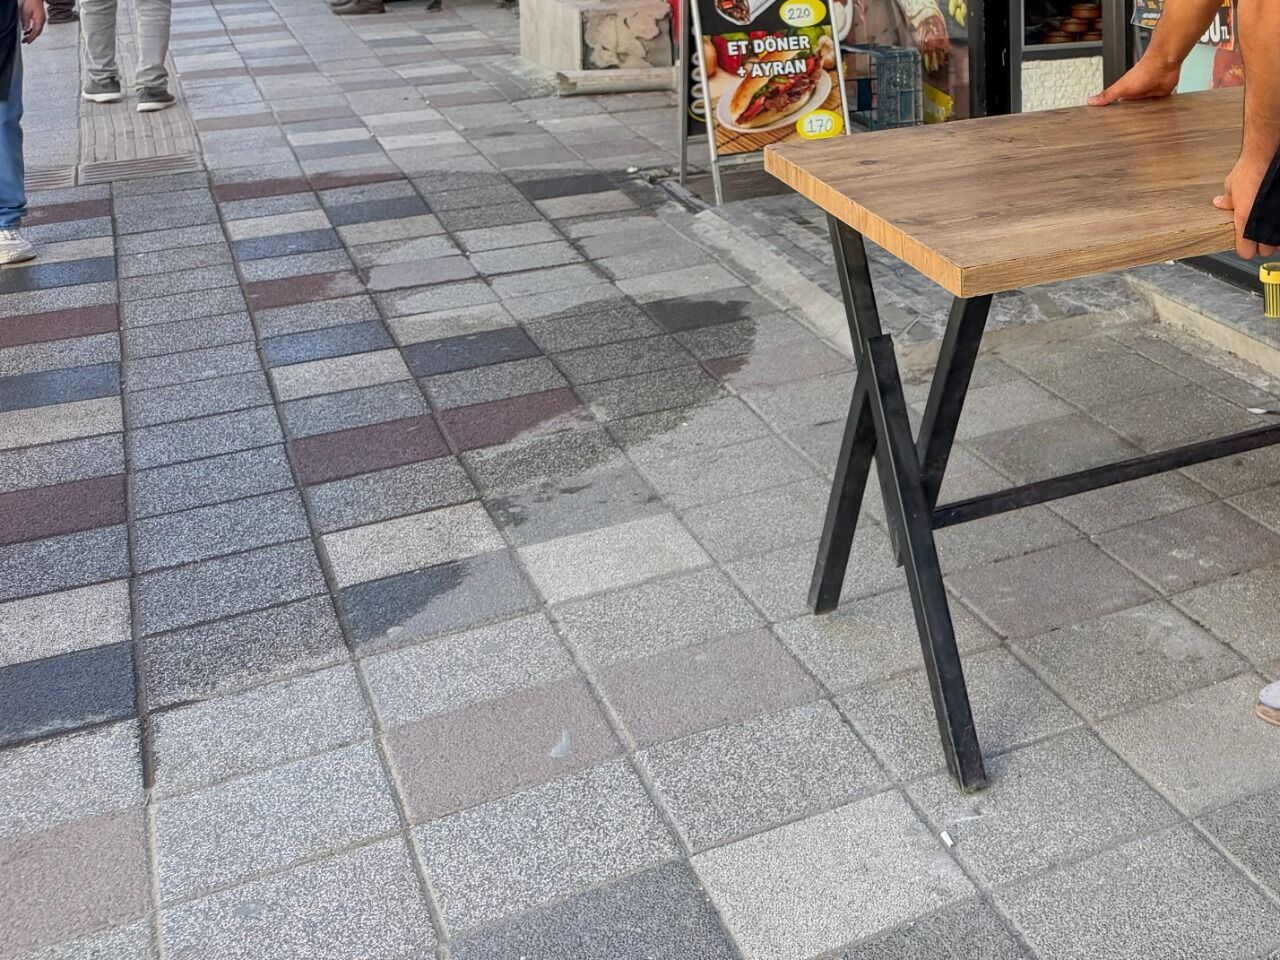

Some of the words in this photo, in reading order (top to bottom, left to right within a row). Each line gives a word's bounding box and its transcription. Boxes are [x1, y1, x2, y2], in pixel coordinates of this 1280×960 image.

[787, 7, 811, 21] 220
[1221, 25, 1230, 39] TL
[727, 40, 749, 56] ET
[753, 35, 811, 54] DÖNER
[751, 58, 807, 78] AYRAN
[806, 118, 833, 133] 170
